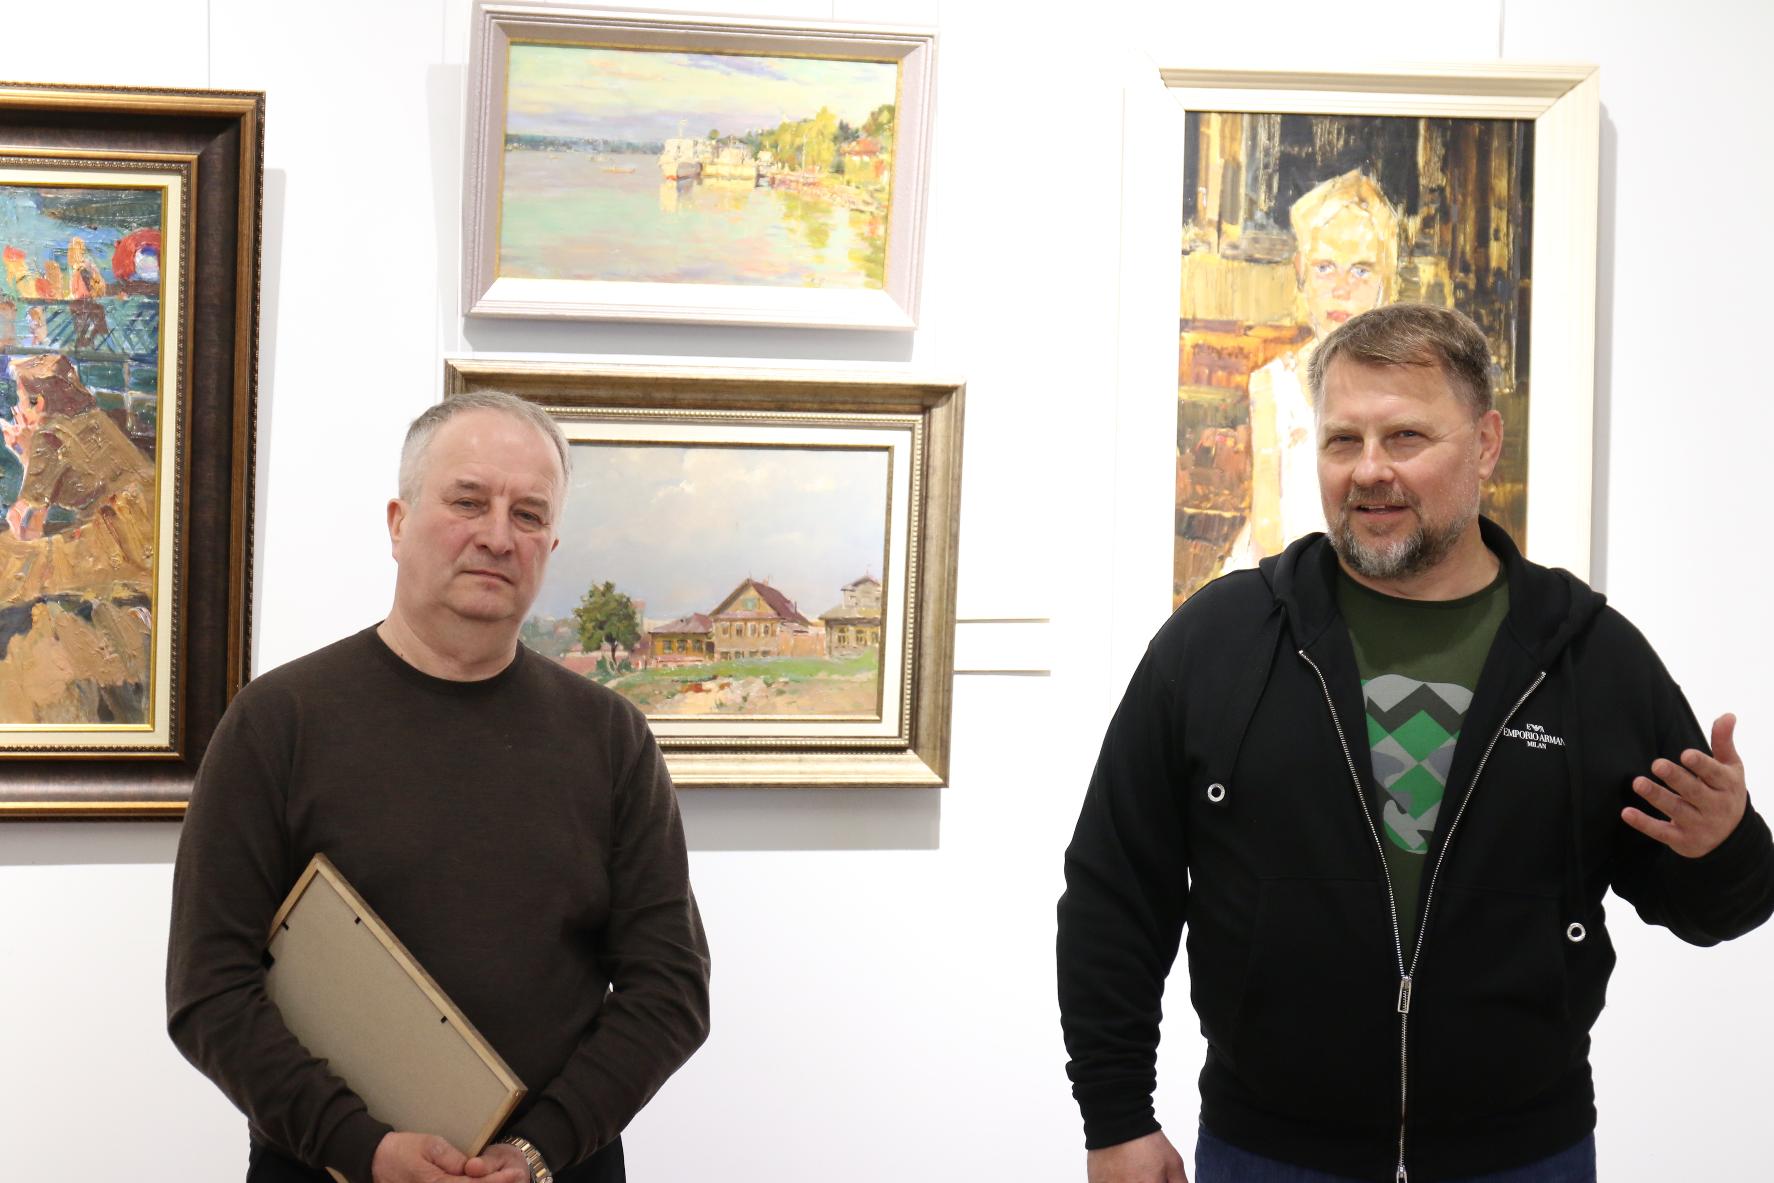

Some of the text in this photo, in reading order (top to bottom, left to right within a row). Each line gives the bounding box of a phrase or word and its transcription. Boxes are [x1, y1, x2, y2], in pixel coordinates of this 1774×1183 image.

[1503, 727, 1566, 746] EMPORIO ARMAN
[1526, 740, 1547, 750] MILAN
